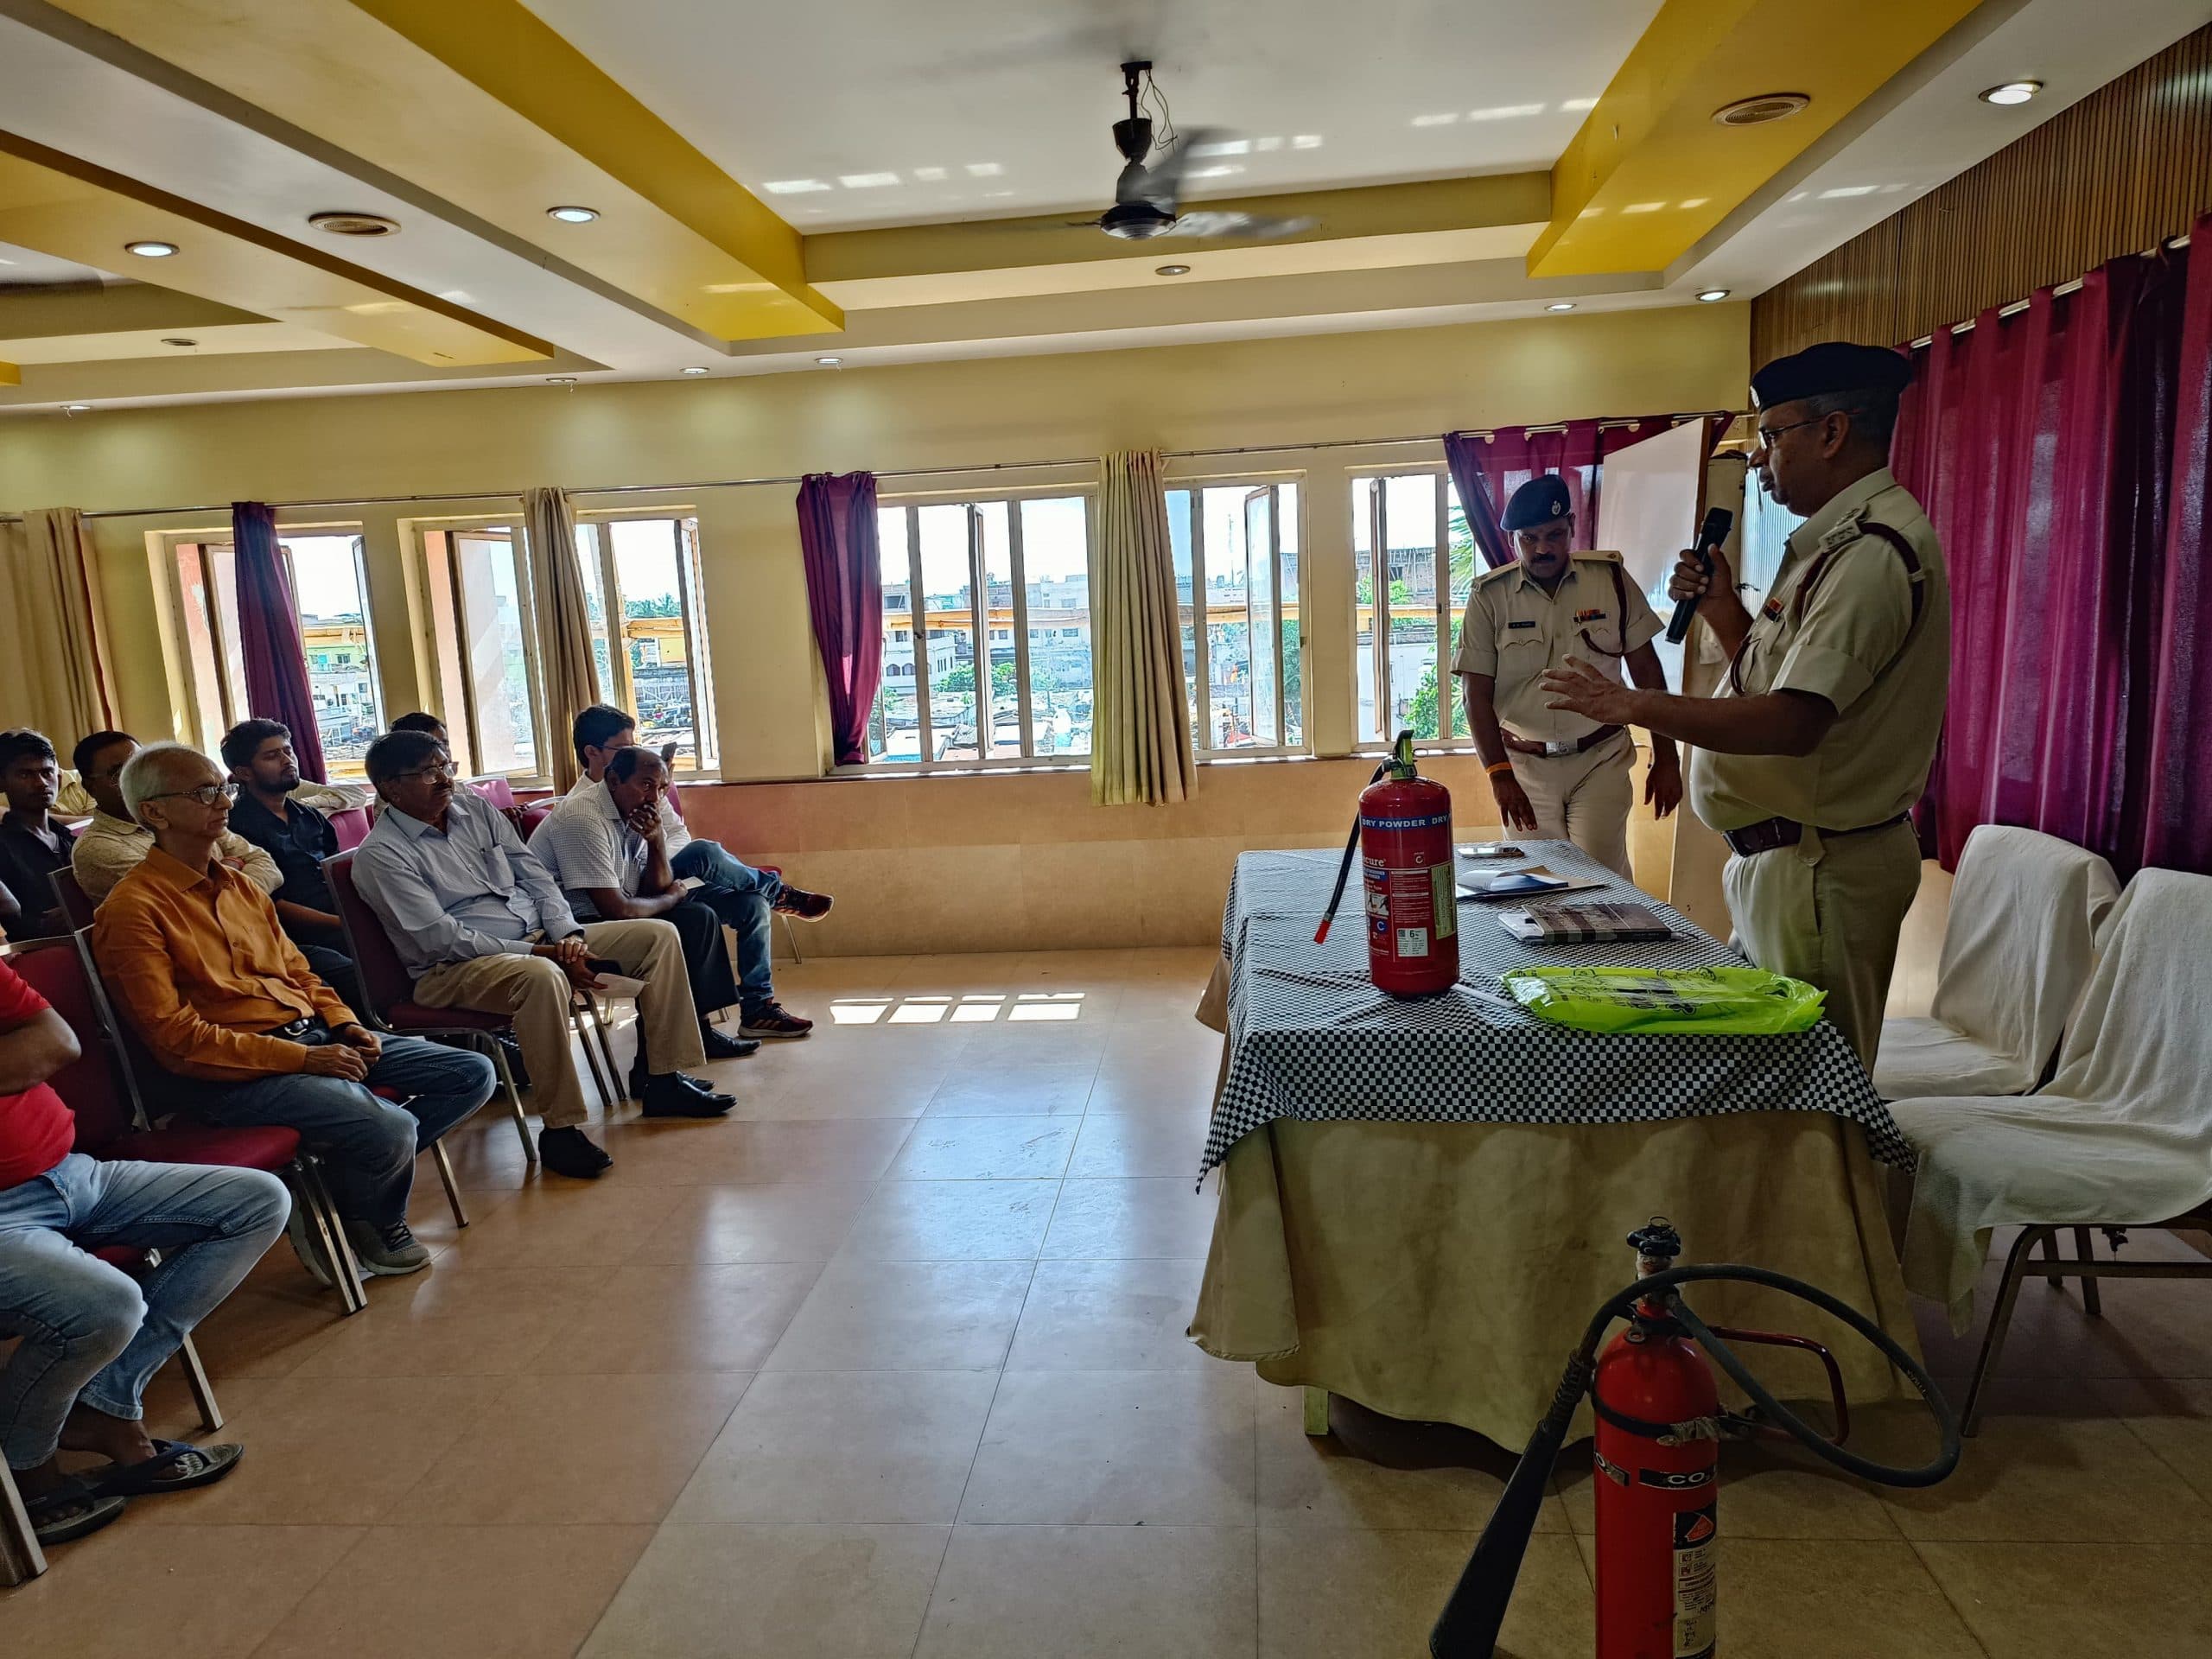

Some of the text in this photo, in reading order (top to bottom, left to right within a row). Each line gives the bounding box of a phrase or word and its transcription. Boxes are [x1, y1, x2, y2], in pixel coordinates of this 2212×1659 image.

[1362, 814, 1448, 829] DRY POWDER DRY
[1376, 921, 1385, 931] C
